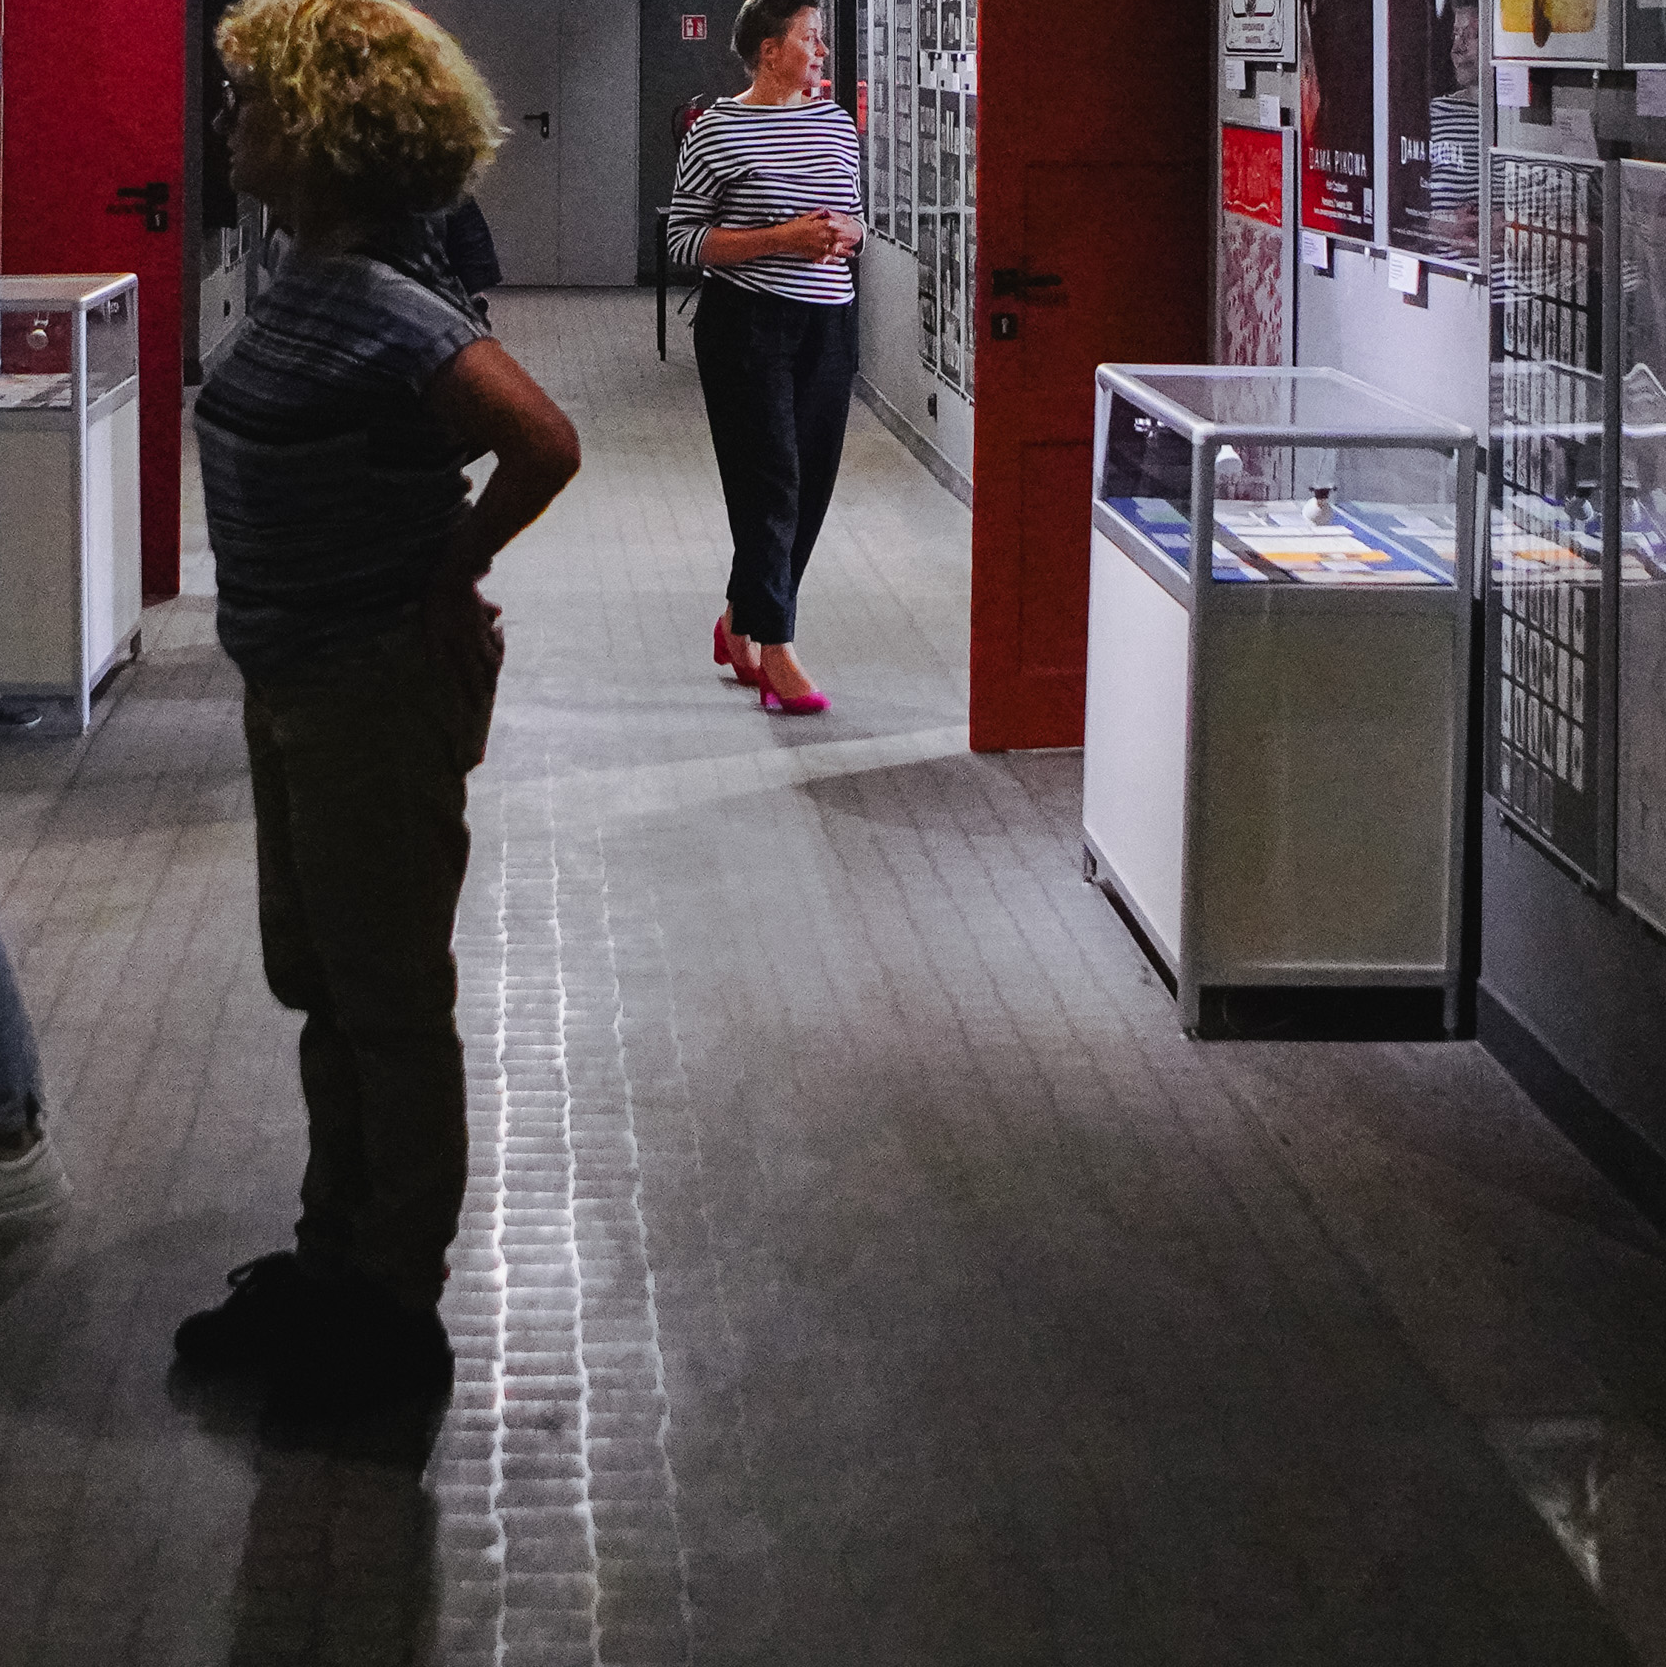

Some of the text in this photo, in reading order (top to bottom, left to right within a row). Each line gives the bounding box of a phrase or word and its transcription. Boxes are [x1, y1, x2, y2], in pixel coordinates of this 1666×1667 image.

[1309, 147, 1367, 177] DAMA PIKOWA
[1401, 135, 1426, 164] DAMA
